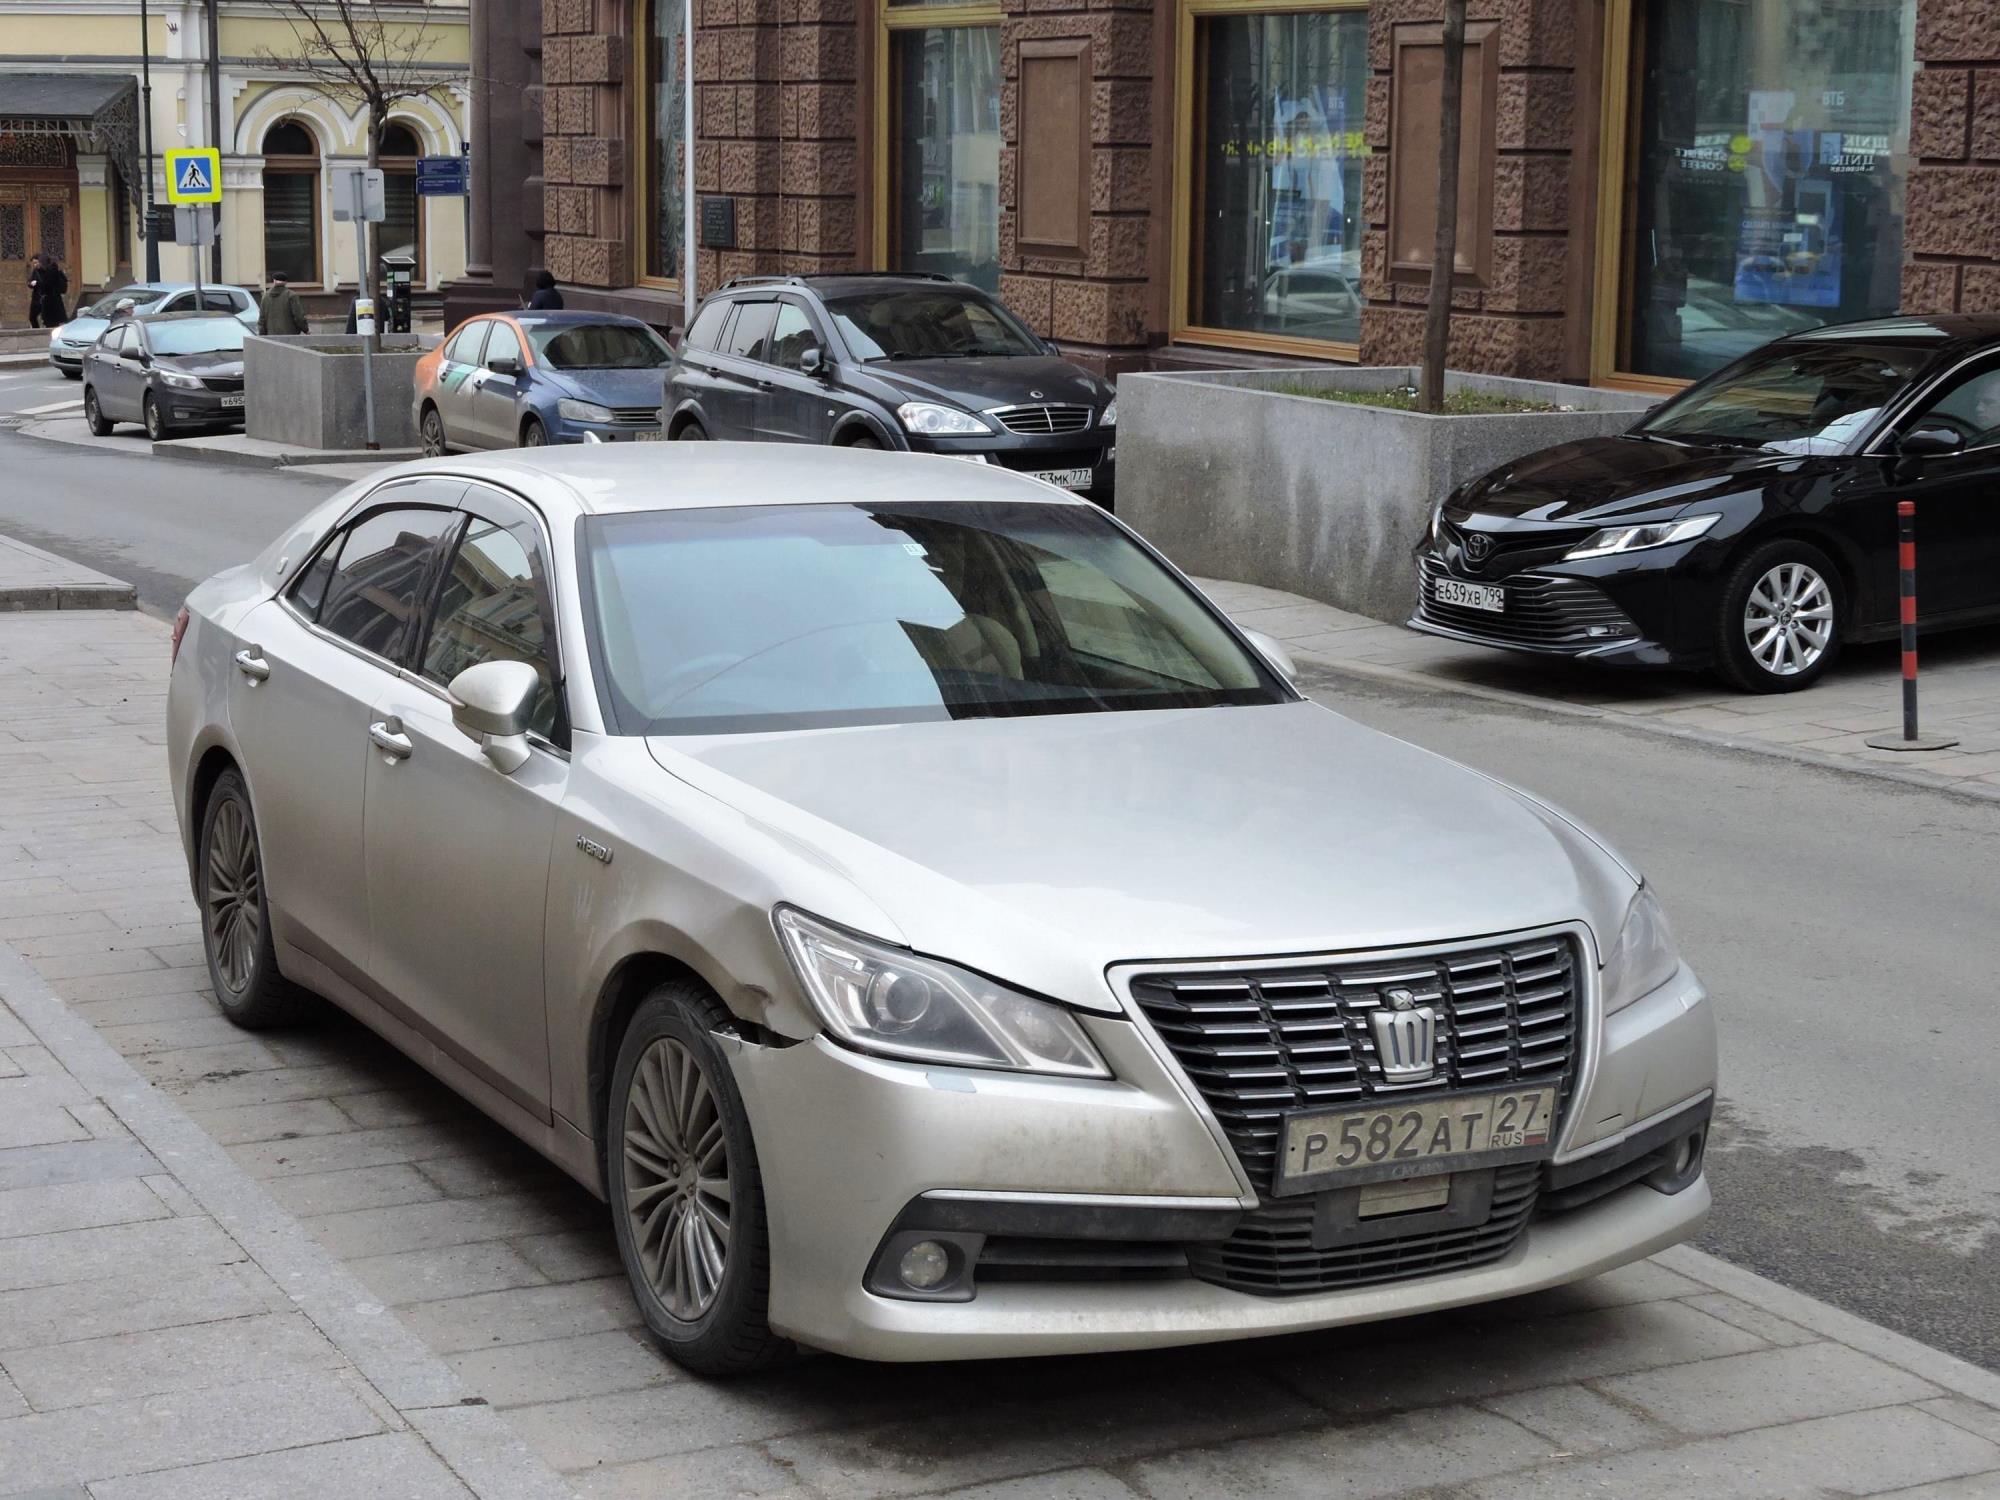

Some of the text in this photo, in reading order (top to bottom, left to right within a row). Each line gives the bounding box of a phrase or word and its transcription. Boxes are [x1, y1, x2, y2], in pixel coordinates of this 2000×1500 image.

[1823, 91, 1845, 106] ВТБ
[1034, 469, 1089, 485] 53МК 777
[1438, 581, 1501, 606] Е639ХВ 799
[576, 834, 611, 862] HYBRID
[1303, 1093, 1542, 1172] Р582АТ 27
[1491, 1131, 1523, 1148] RUS
